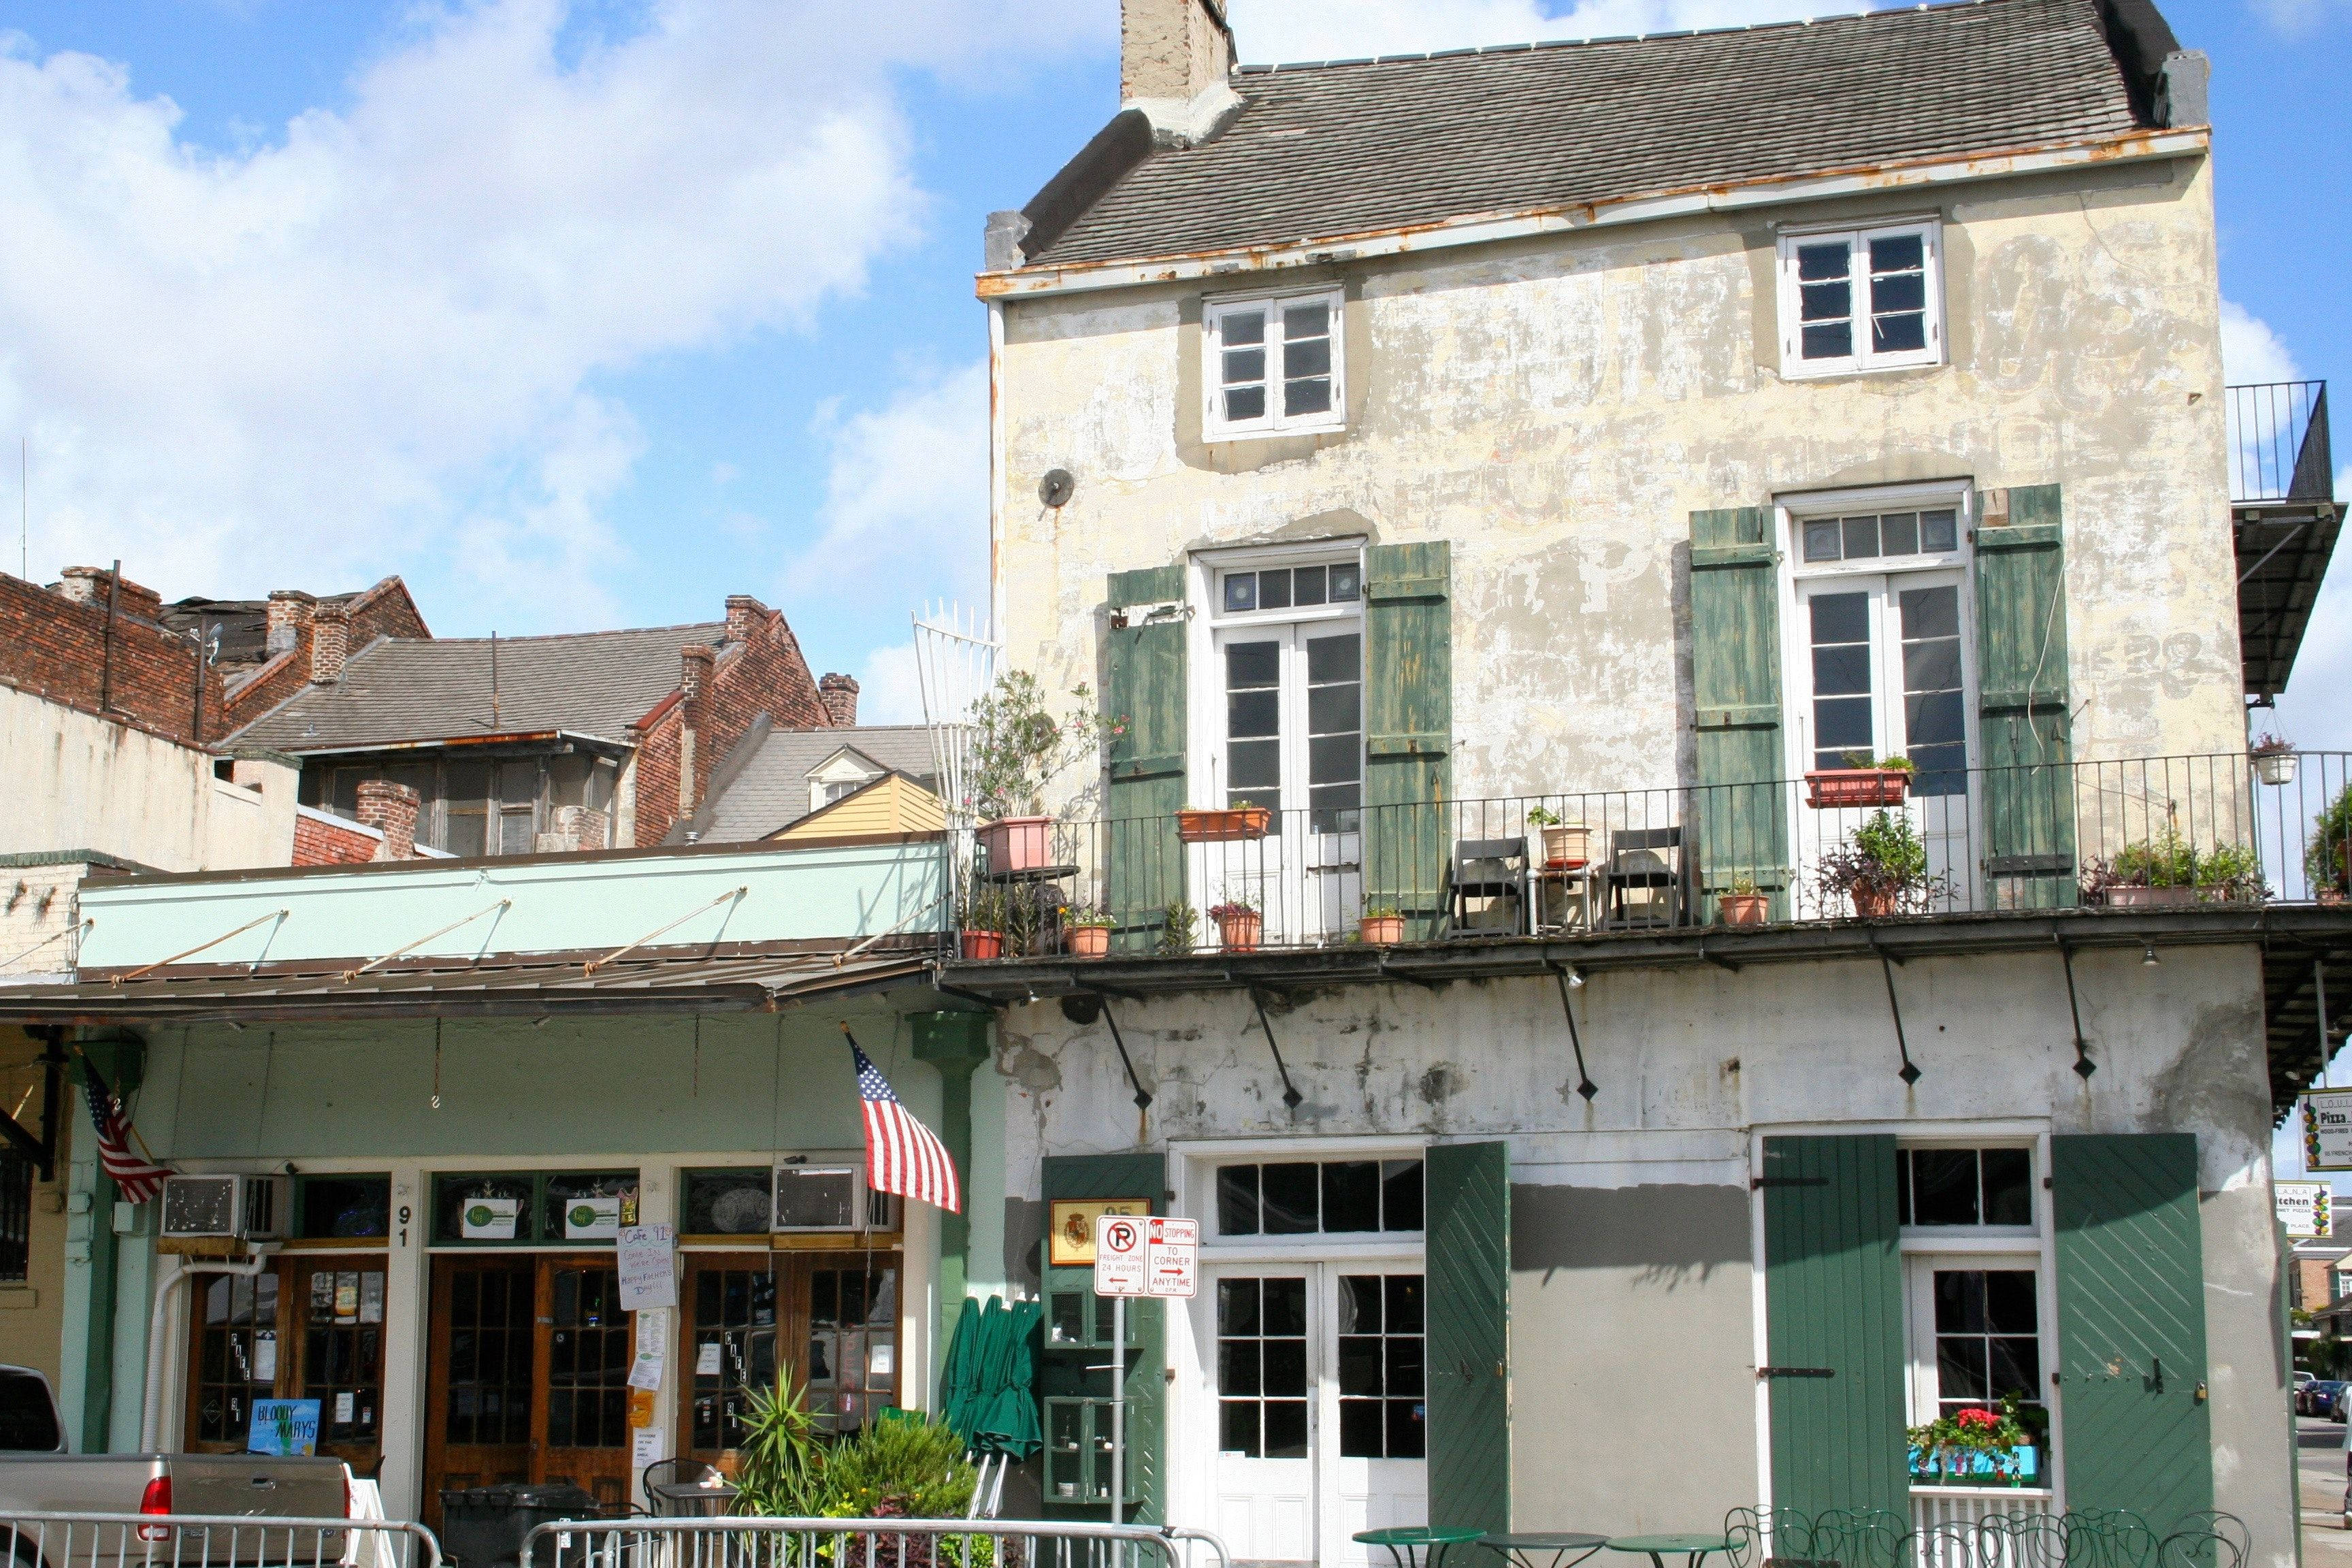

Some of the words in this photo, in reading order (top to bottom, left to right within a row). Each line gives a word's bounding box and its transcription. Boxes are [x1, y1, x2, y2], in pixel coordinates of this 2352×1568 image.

[2320, 1111, 2347, 1124] Pizza
[653, 1226, 667, 1241] 91
[1150, 1224, 1163, 1239] NO
[1164, 1228, 1194, 1239] STOPPING
[1100, 1254, 1124, 1262] FREIGHT
[1167, 1247, 1178, 1256] TO
[1154, 1256, 1190, 1266] CORNER
[1115, 1264, 1142, 1273] HOURS
[1152, 1277, 1192, 1287] ANYTIME
[725, 1332, 747, 1382] CAFE
[258, 1405, 297, 1422] BLOODY
[275, 1420, 316, 1439] MARYS
